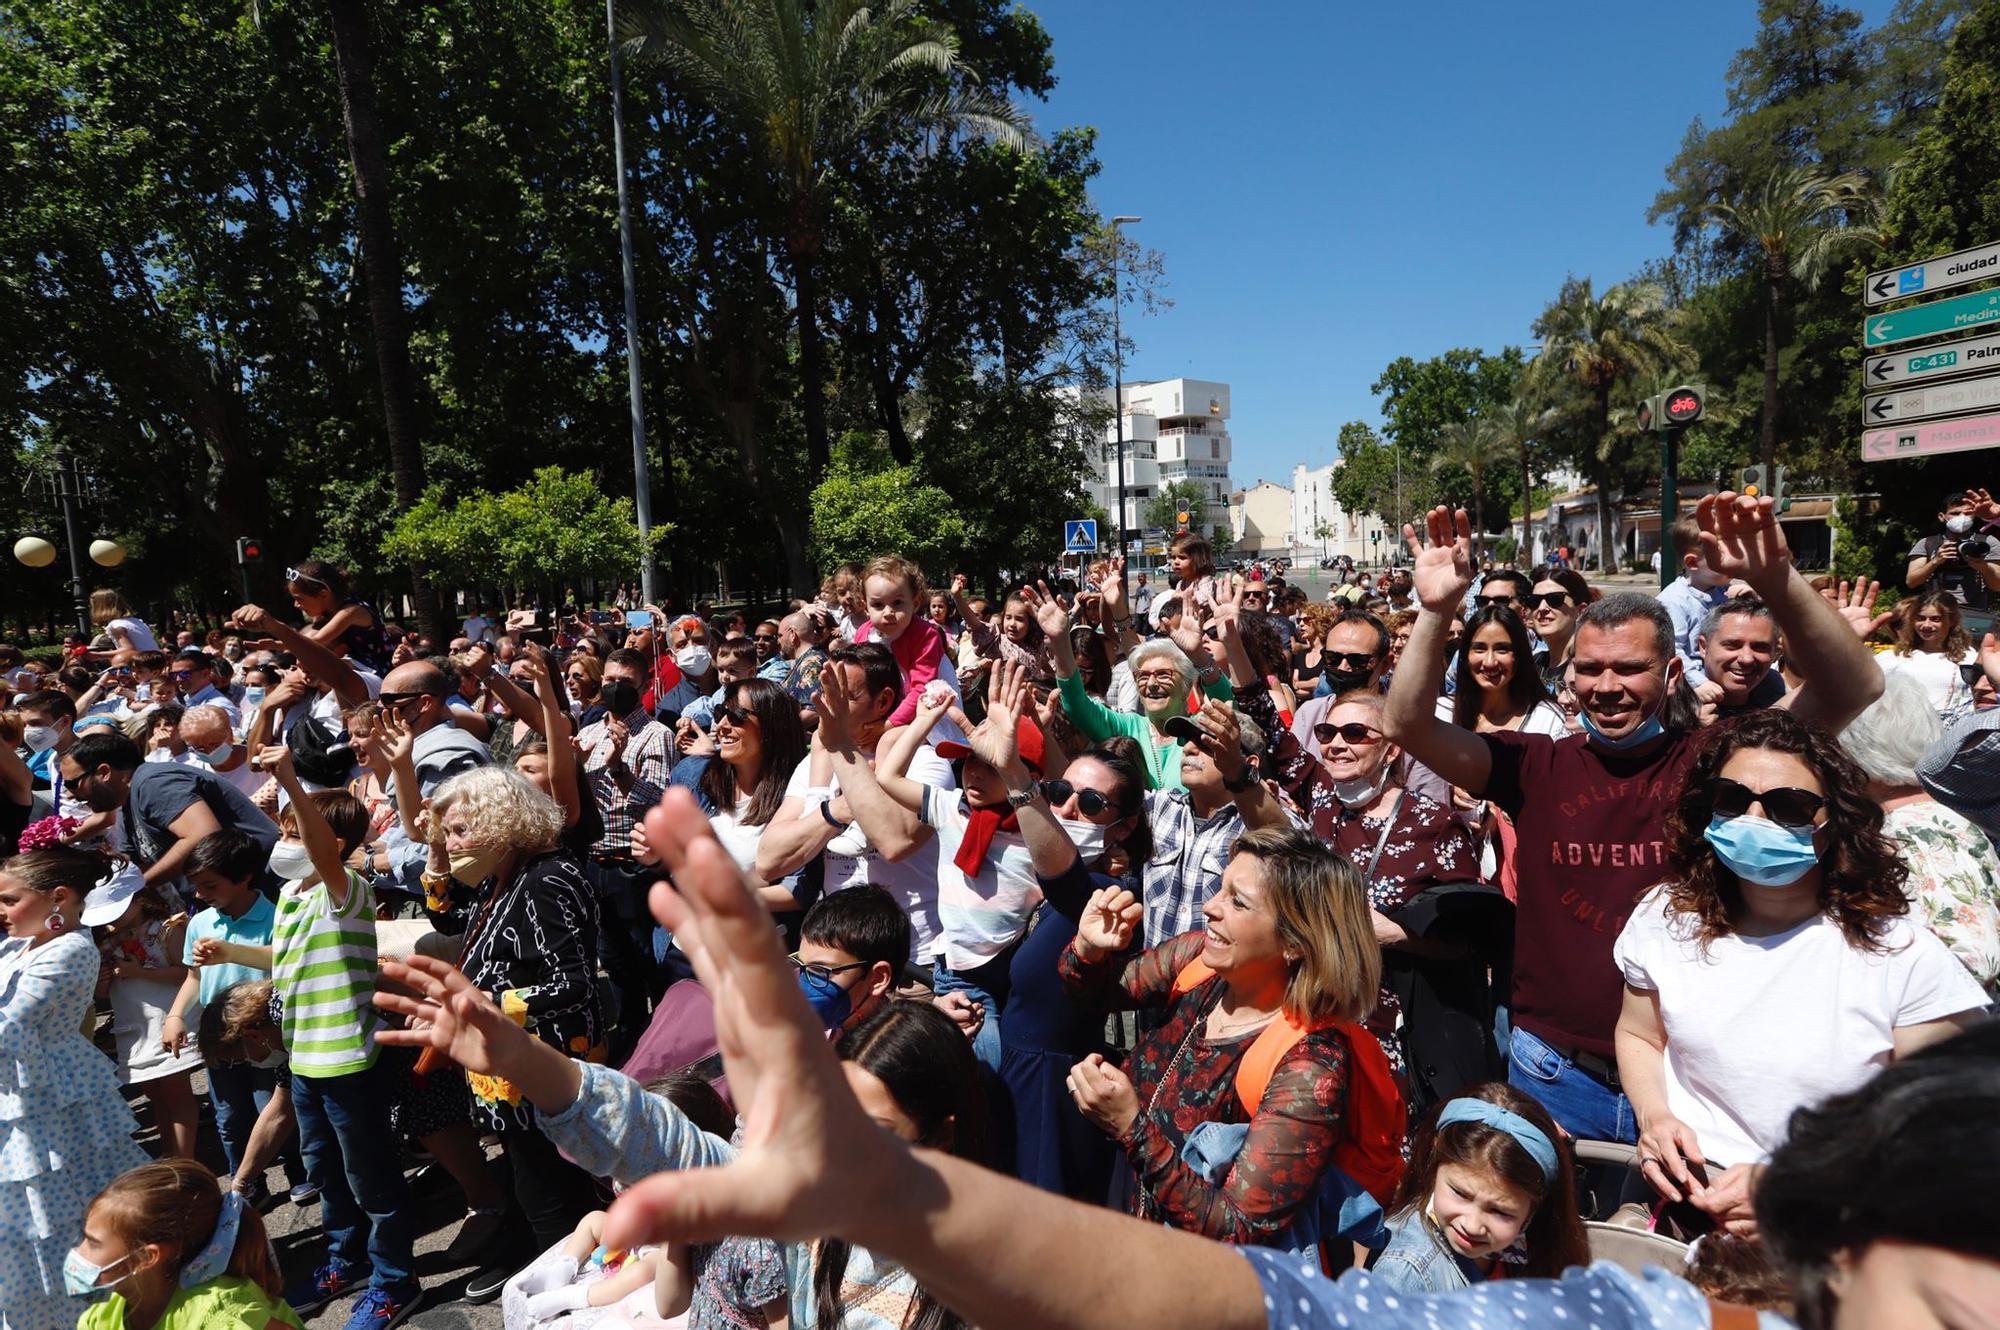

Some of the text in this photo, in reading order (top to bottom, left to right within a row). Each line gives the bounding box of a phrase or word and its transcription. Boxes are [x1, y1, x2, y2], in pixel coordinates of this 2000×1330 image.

[1946, 254, 1998, 276] ciudad
[1953, 308, 2000, 325] Medin
[1911, 352, 1955, 370] C-431
[1551, 841, 1664, 867] ADVENT
